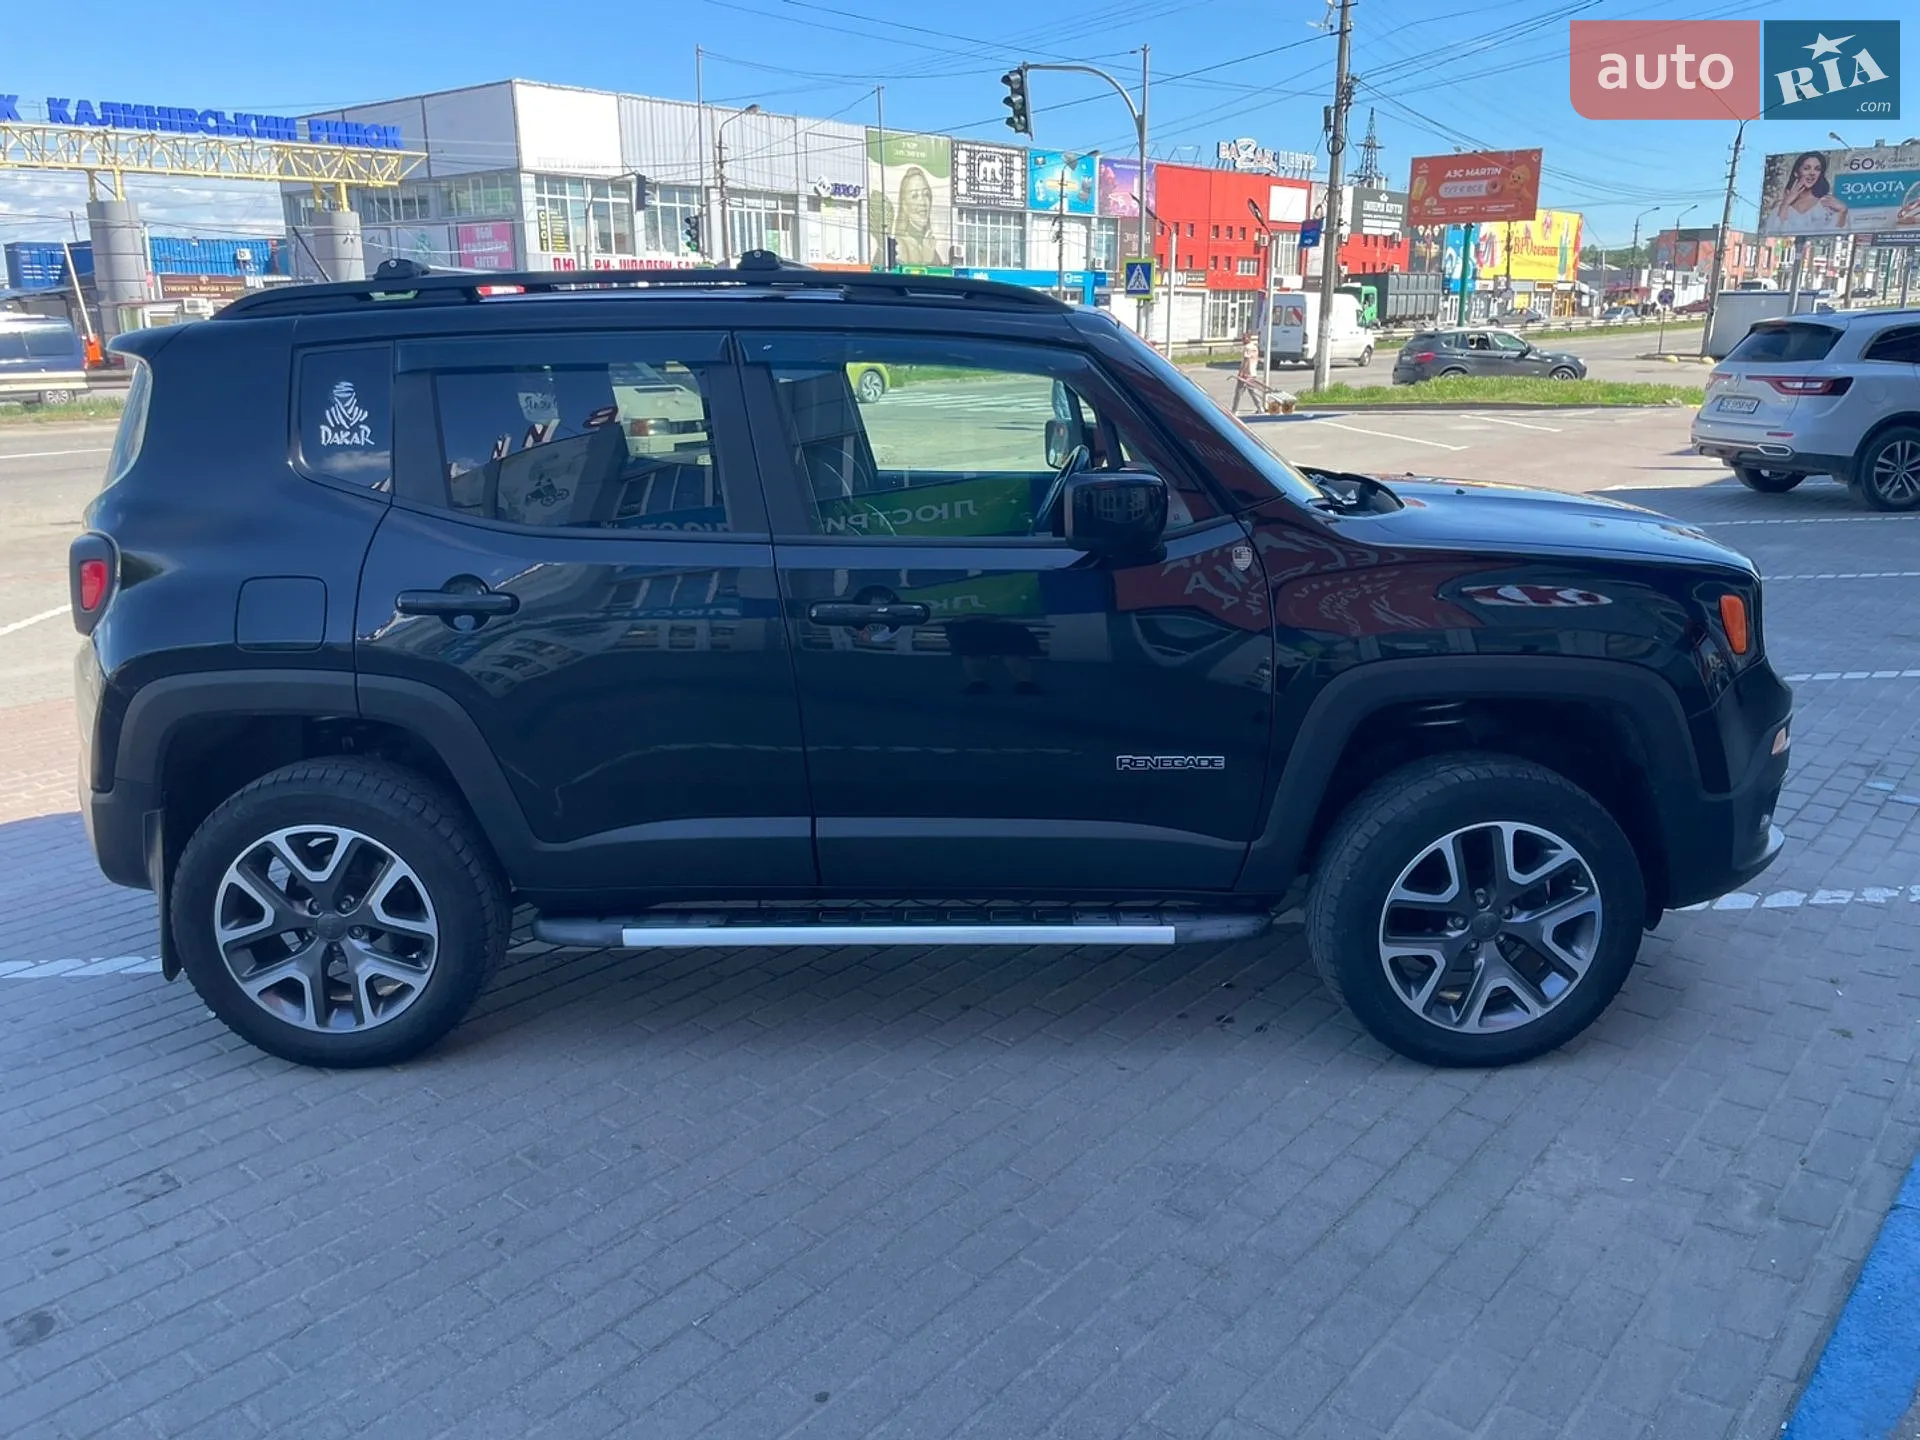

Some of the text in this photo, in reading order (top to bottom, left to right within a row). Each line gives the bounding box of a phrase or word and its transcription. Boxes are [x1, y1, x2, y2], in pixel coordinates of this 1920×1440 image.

[307, 119, 404, 149] РИНОК
[1465, 167, 1502, 177] MARTIN
[1841, 180, 1905, 195] ЗОЛОТА
[320, 424, 375, 446] DAKAR
[1116, 755, 1225, 770] RENEGADE
